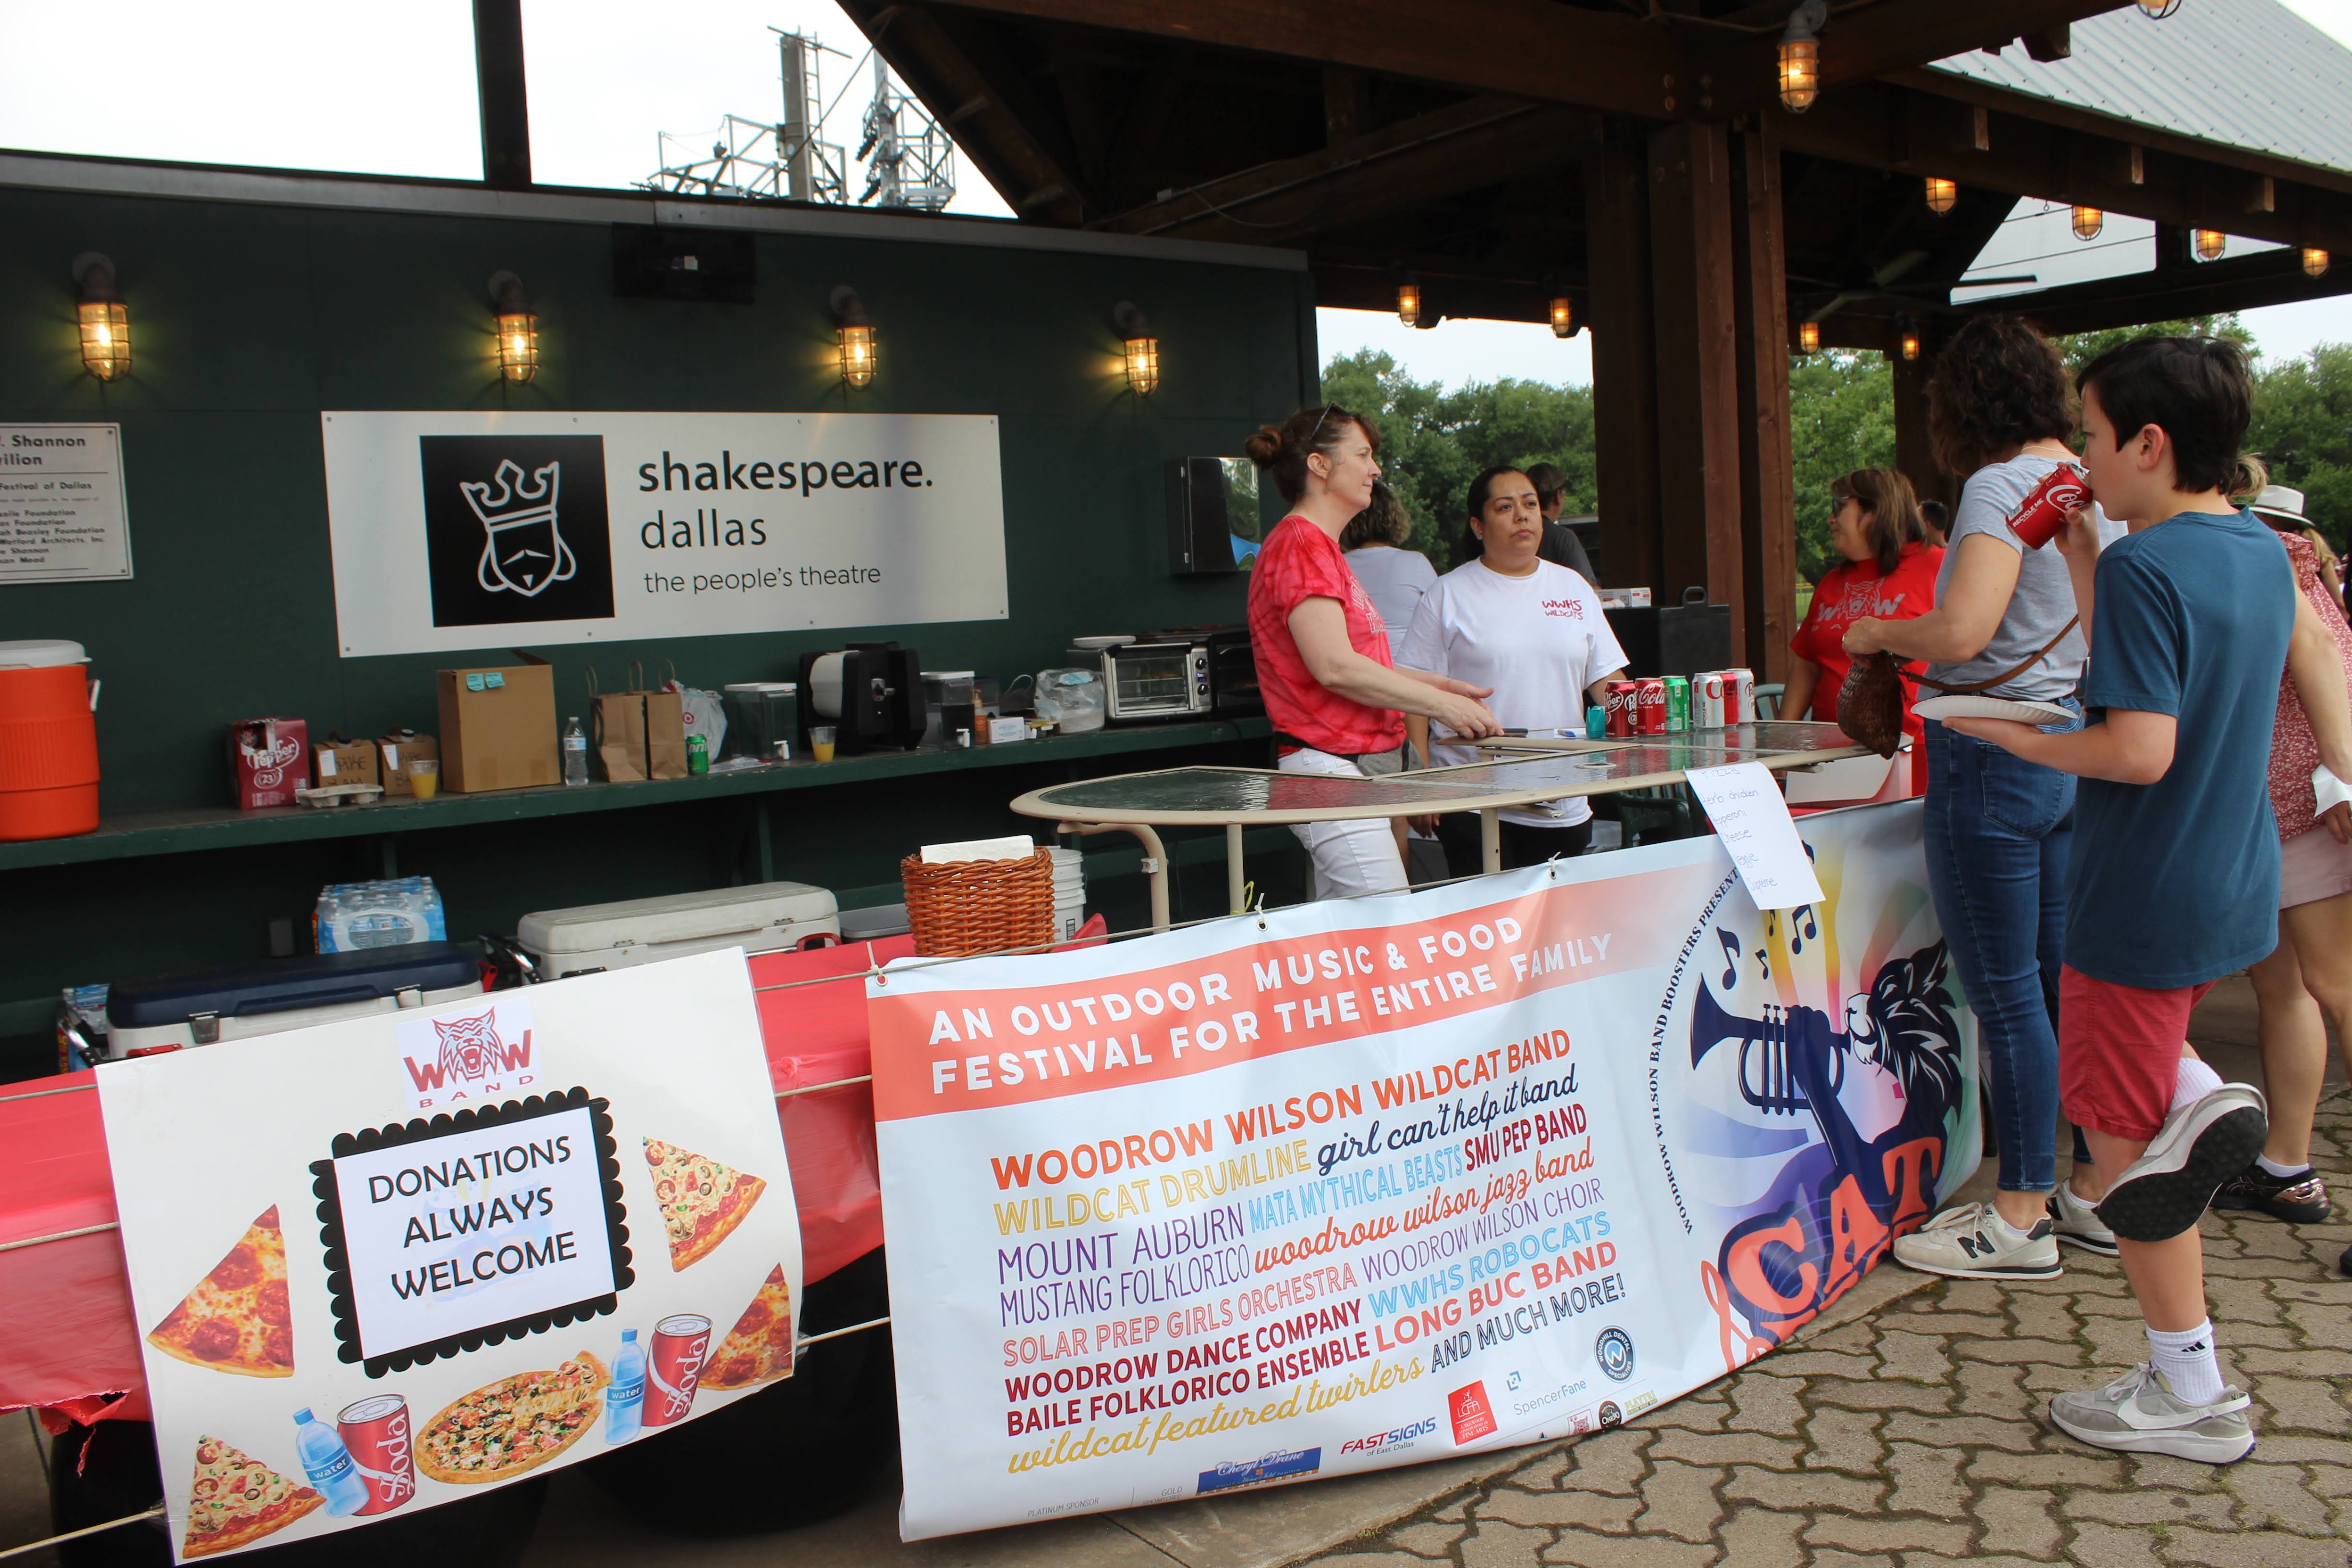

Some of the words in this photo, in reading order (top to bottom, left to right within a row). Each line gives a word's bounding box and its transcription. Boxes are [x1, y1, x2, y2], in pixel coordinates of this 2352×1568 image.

[12, 435, 86, 447] Shannon
[60, 482, 92, 490] Dallas
[639, 450, 934, 497] shakespeare.
[641, 509, 767, 548] dallas
[2012, 506, 2037, 527] RECYCLE
[2034, 498, 2044, 508] ME
[644, 571, 685, 594] the
[693, 567, 793, 596] people's
[799, 564, 881, 586] theatre
[1542, 599, 1582, 611] WWHS
[1545, 610, 1583, 620] WILDCATS
[929, 1008, 994, 1045] AN
[1011, 973, 1232, 1035] OUTDOOR
[1252, 945, 1373, 992] MUSIC
[1386, 942, 1408, 971] &
[1418, 917, 1522, 963] FOOD
[1661, 926, 1702, 1012] BOOSTERS
[933, 1033, 1152, 1094] FESTIVAL
[1170, 1011, 1260, 1058] FOR
[1274, 990, 1360, 1033] THE
[1373, 964, 1497, 1015] ENTIRE
[1511, 934, 1611, 982] FAMILY
[1649, 1013, 1668, 1064] BAND
[420, 1075, 533, 1108] BAND
[991, 1119, 1213, 1190] WOODROW
[1224, 1084, 1363, 1145] WILSON
[1371, 1049, 1501, 1110] WILDCAT
[1508, 1029, 1570, 1073] BAND
[1649, 1065, 1664, 1140] WILSON
[368, 1136, 571, 1203] DONATIONS
[993, 1179, 1150, 1236] WILDCAT
[1160, 1139, 1311, 1208] DRUMLINE
[1318, 1120, 1381, 1176] girl
[1387, 1103, 1451, 1149] can't
[1453, 1098, 1502, 1132] help
[1503, 1081, 1522, 1115] it
[1521, 1063, 1578, 1104] band
[998, 1233, 1118, 1284] MOUNT
[1132, 1203, 1244, 1264] AUBURN
[1249, 1189, 1298, 1233] MATA
[1299, 1164, 1402, 1218] MYTHICAL
[1405, 1145, 1462, 1191] BEASTS
[1464, 1137, 1500, 1171] SMU
[1503, 1118, 1531, 1157] PEP
[1534, 1103, 1587, 1145] BAND
[1659, 1142, 1693, 1236] WOODROW
[403, 1187, 553, 1248] ALWAYS
[1001, 1276, 1112, 1327] MUSTANG
[1121, 1243, 1249, 1307] FOLKLORICO
[1254, 1216, 1399, 1273] woodrow
[1404, 1186, 1479, 1232] wilson
[1480, 1168, 1532, 1214] jazz
[1536, 1136, 1595, 1183] band
[391, 1231, 577, 1300] WELCOME
[1004, 1327, 1087, 1367] SOLAR
[1096, 1316, 1159, 1351] PREP
[1167, 1299, 1233, 1339] GIRLS
[1238, 1262, 1358, 1320] ORCHESTRA
[1361, 1224, 1468, 1283] WOODROW
[1472, 1197, 1539, 1244] WILSON
[1544, 1178, 1604, 1217] CHOIR
[1005, 1353, 1158, 1402] WOODROW
[1167, 1333, 1251, 1374] DANCE
[1256, 1299, 1361, 1353] COMPANY
[1368, 1264, 1464, 1317] WWHS
[1469, 1211, 1611, 1282] ROBOCATS
[1007, 1399, 1081, 1436] BAILE
[1091, 1368, 1249, 1421] FOLKLORICO
[1257, 1331, 1370, 1389] ENSEMBLE
[1375, 1298, 1461, 1352] LONG
[1468, 1272, 1526, 1316] BUC
[1531, 1241, 1616, 1289] BAND
[1598, 1331, 1613, 1362] WOODHILL
[1613, 1331, 1631, 1352] DENTAL
[611, 1386, 640, 1399] water
[663, 1336, 707, 1417] Soda
[1008, 1416, 1150, 1473] wildcat
[1147, 1384, 1301, 1456] featured
[1305, 1356, 1425, 1411] twirlers
[1431, 1331, 1472, 1373] AND
[1477, 1301, 1547, 1349] MUCH
[1551, 1273, 1626, 1322] MORE!
[1608, 1361, 1632, 1379] SPECIALTIES
[1457, 1400, 1480, 1418] LCFA
[1513, 1378, 1586, 1416] SpencerFane
[376, 1413, 412, 1502] Soda
[1341, 1417, 1436, 1454] FASTSIGNS
[1394, 1441, 1414, 1451] Dallas
[314, 1459, 346, 1479] water
[1162, 1486, 1182, 1497] GOLD
[1215, 1461, 1261, 1476] Cheryl
[1027, 1505, 1064, 1517] PLATINUM
[1066, 1497, 1099, 1511] SPONSOR
